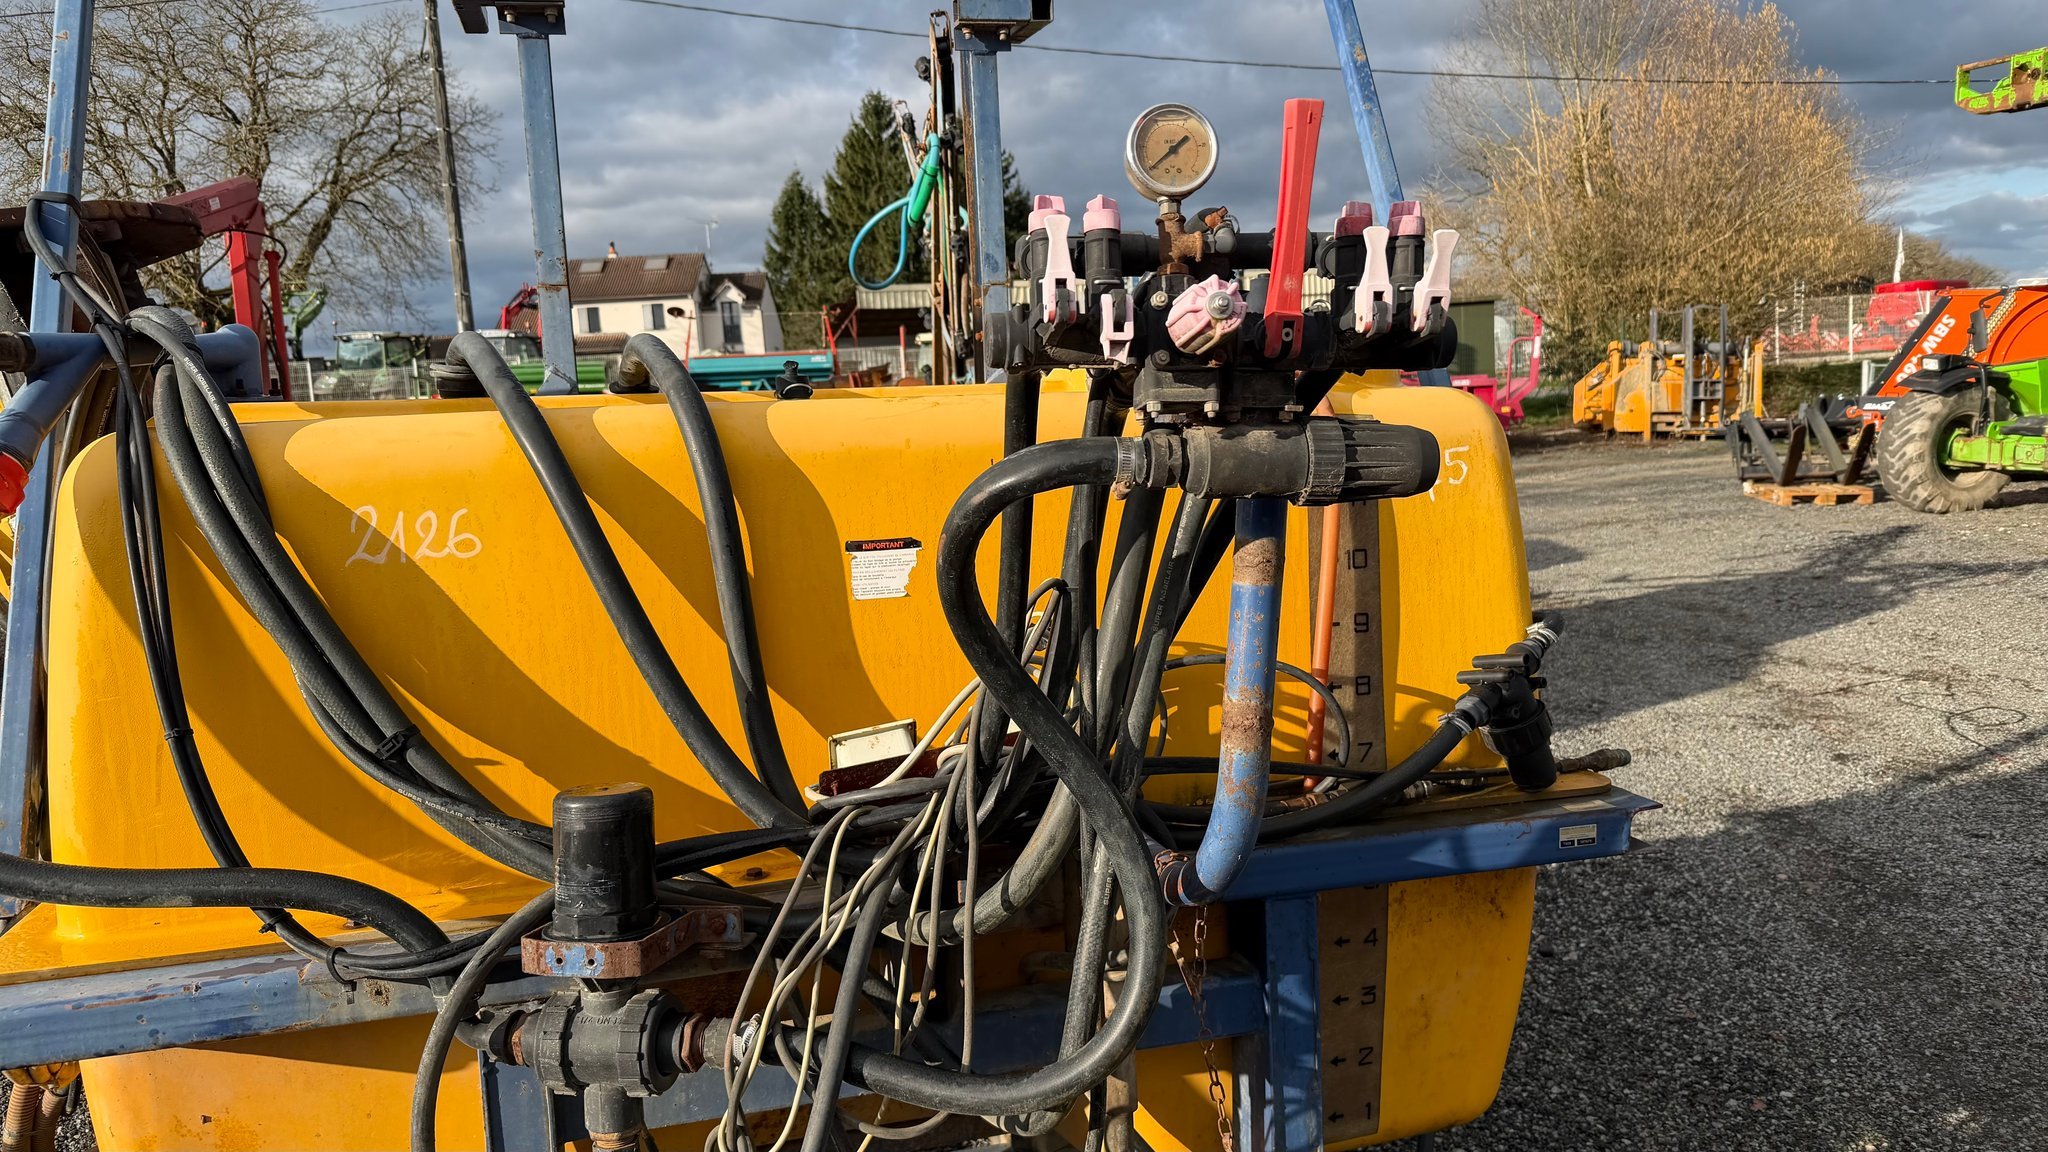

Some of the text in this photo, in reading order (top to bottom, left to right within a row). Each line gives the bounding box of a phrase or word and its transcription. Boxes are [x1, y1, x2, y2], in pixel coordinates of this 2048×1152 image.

[1921, 314, 1957, 355] SBW
[183, 356, 199, 374] SUPER
[345, 504, 483, 568] 2126
[862, 541, 905, 550] IMPORTANT
[1345, 549, 1368, 571] 10
[1151, 604, 1165, 632] SUPER
[1354, 612, 1370, 633] 9
[1355, 675, 1371, 696] 8
[1357, 742, 1374, 763] 7
[397, 788, 423, 803] SUPER
[424, 800, 464, 819] NOBELAIR
[1103, 876, 1114, 906] SUPER
[1363, 927, 1379, 947] 4
[1361, 985, 1377, 1006] 3
[1358, 1046, 1374, 1067] 2
[1364, 1102, 1372, 1120] 1
